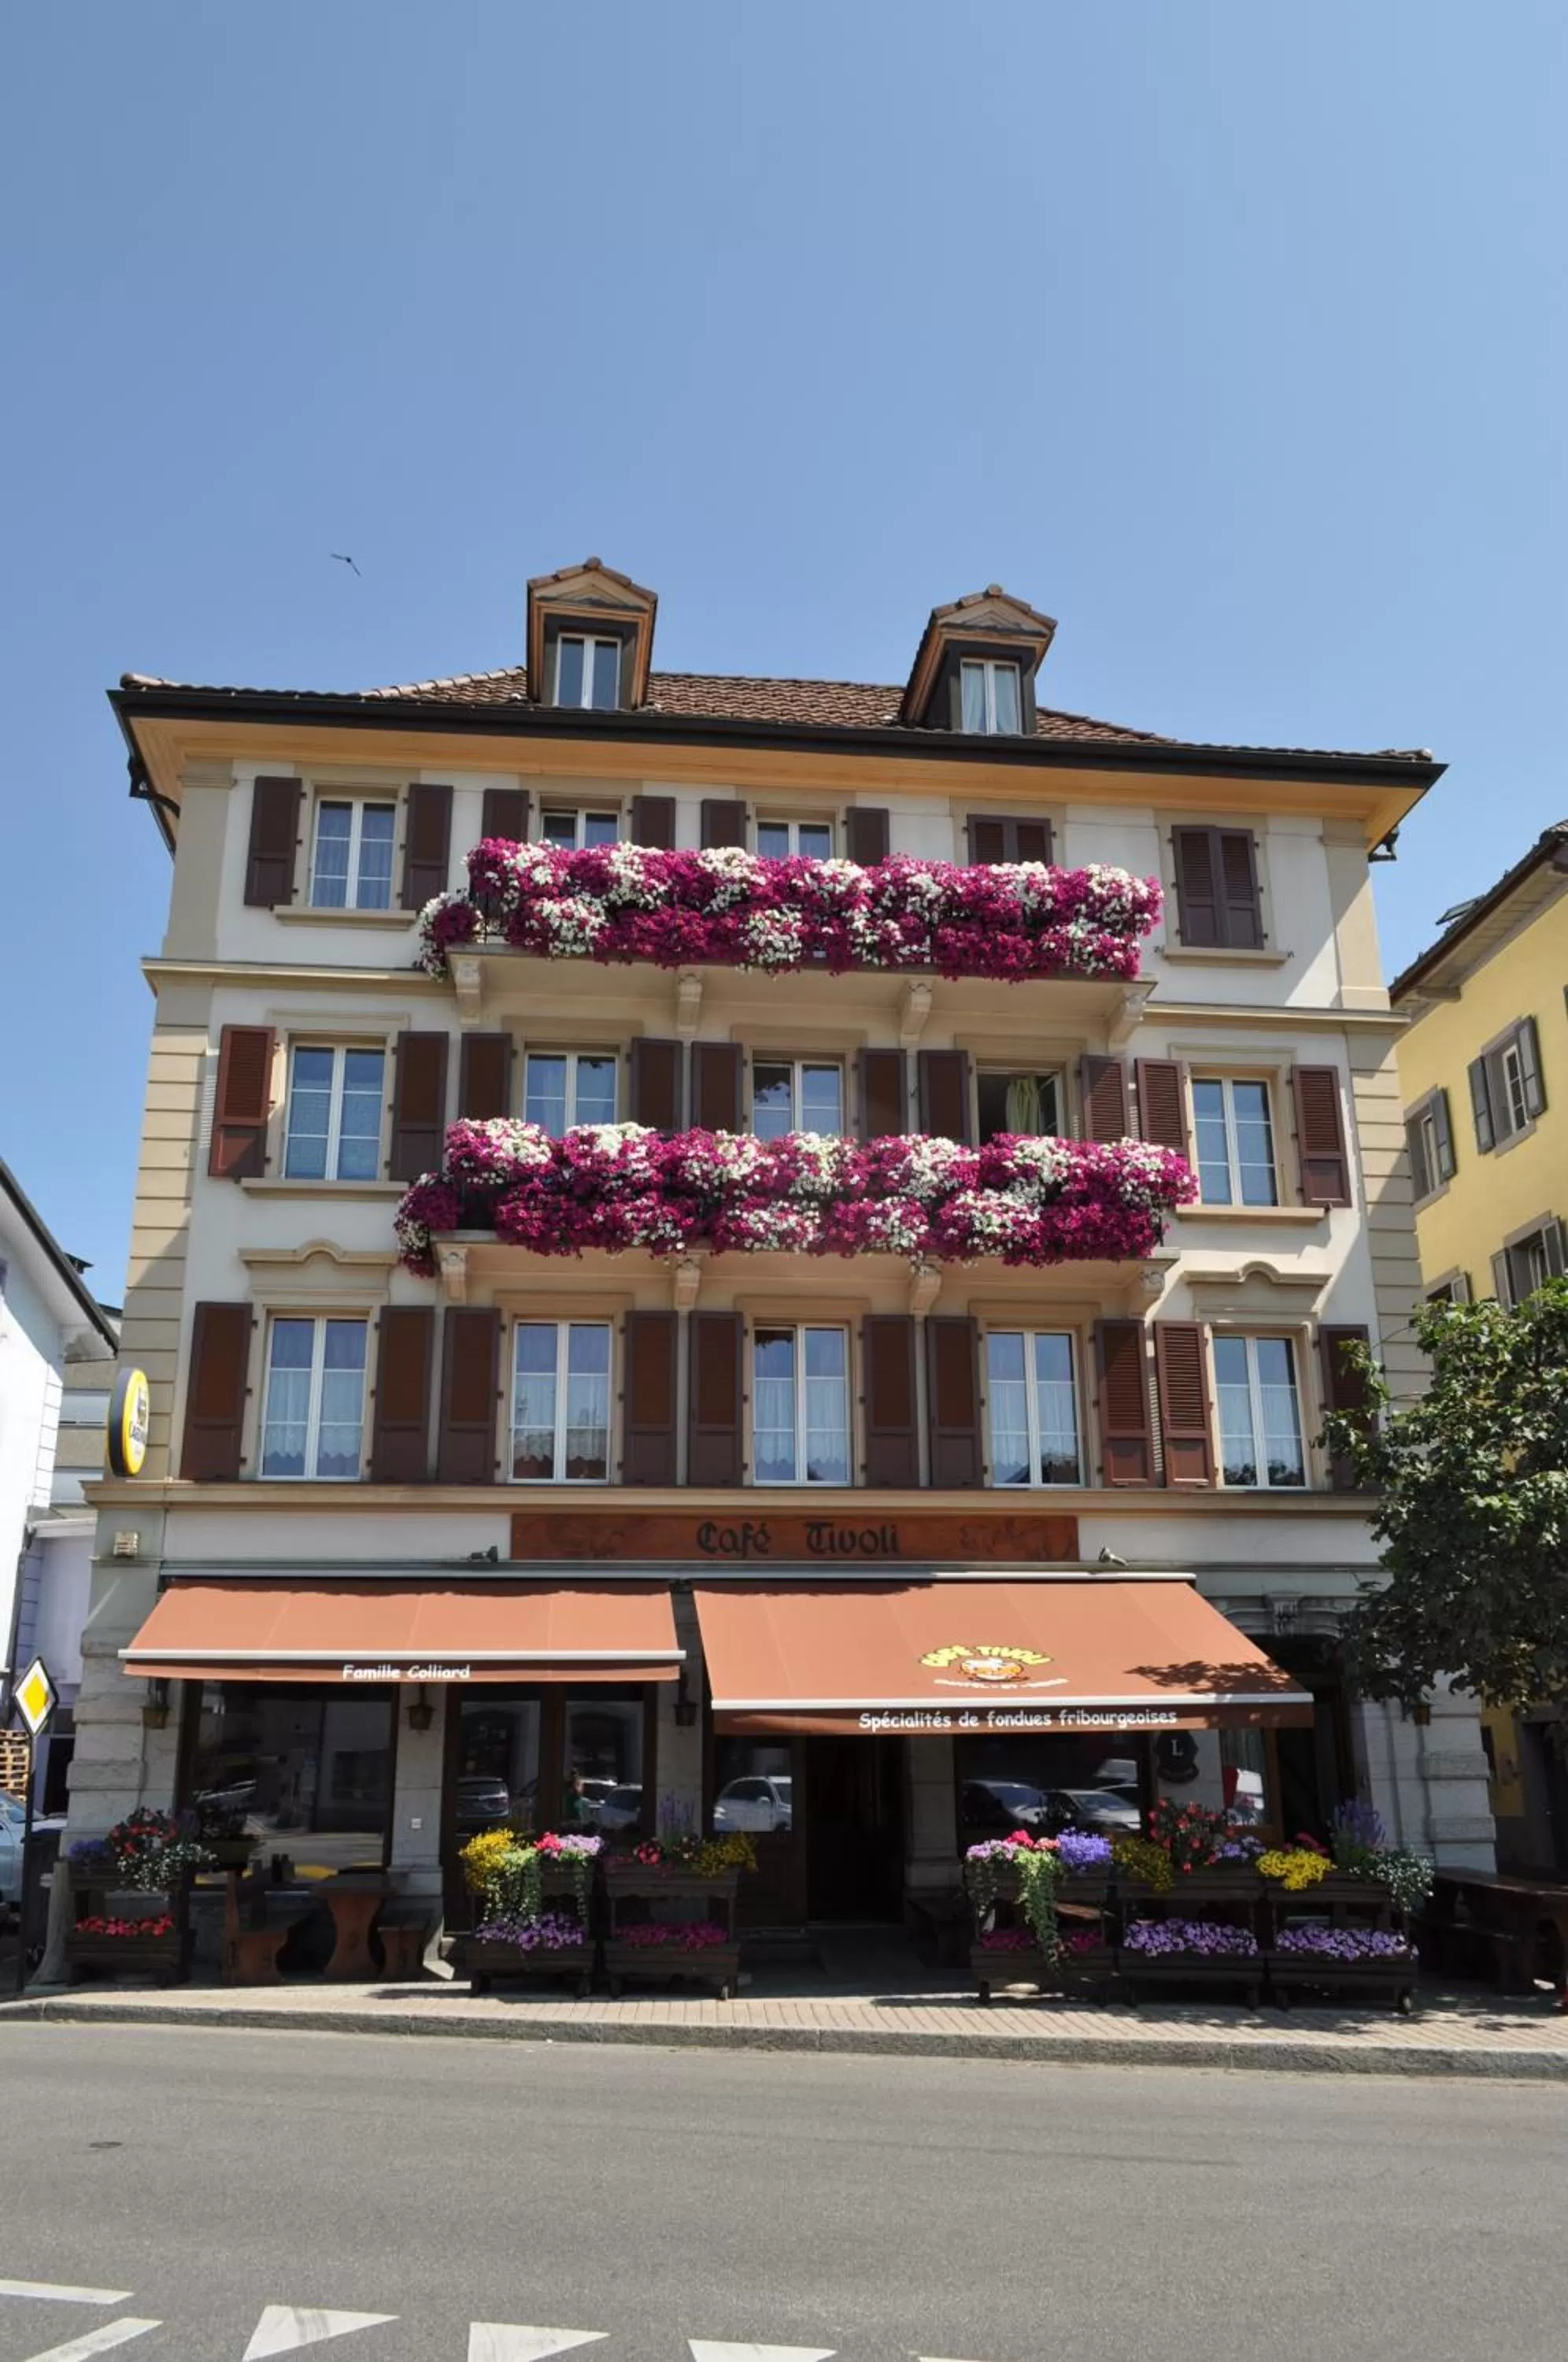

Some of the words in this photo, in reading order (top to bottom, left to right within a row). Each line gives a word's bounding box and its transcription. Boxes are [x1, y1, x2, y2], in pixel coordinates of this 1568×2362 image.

[696, 1521, 772, 1560] Café
[803, 1520, 900, 1555] Tivoli
[342, 1664, 401, 1680] Famille
[407, 1663, 471, 1679] Colliard
[859, 1710, 952, 1732] Spécialités
[958, 1711, 980, 1727] de
[986, 1709, 1052, 1728] fondues
[1059, 1708, 1178, 1729] fribourgeoises
